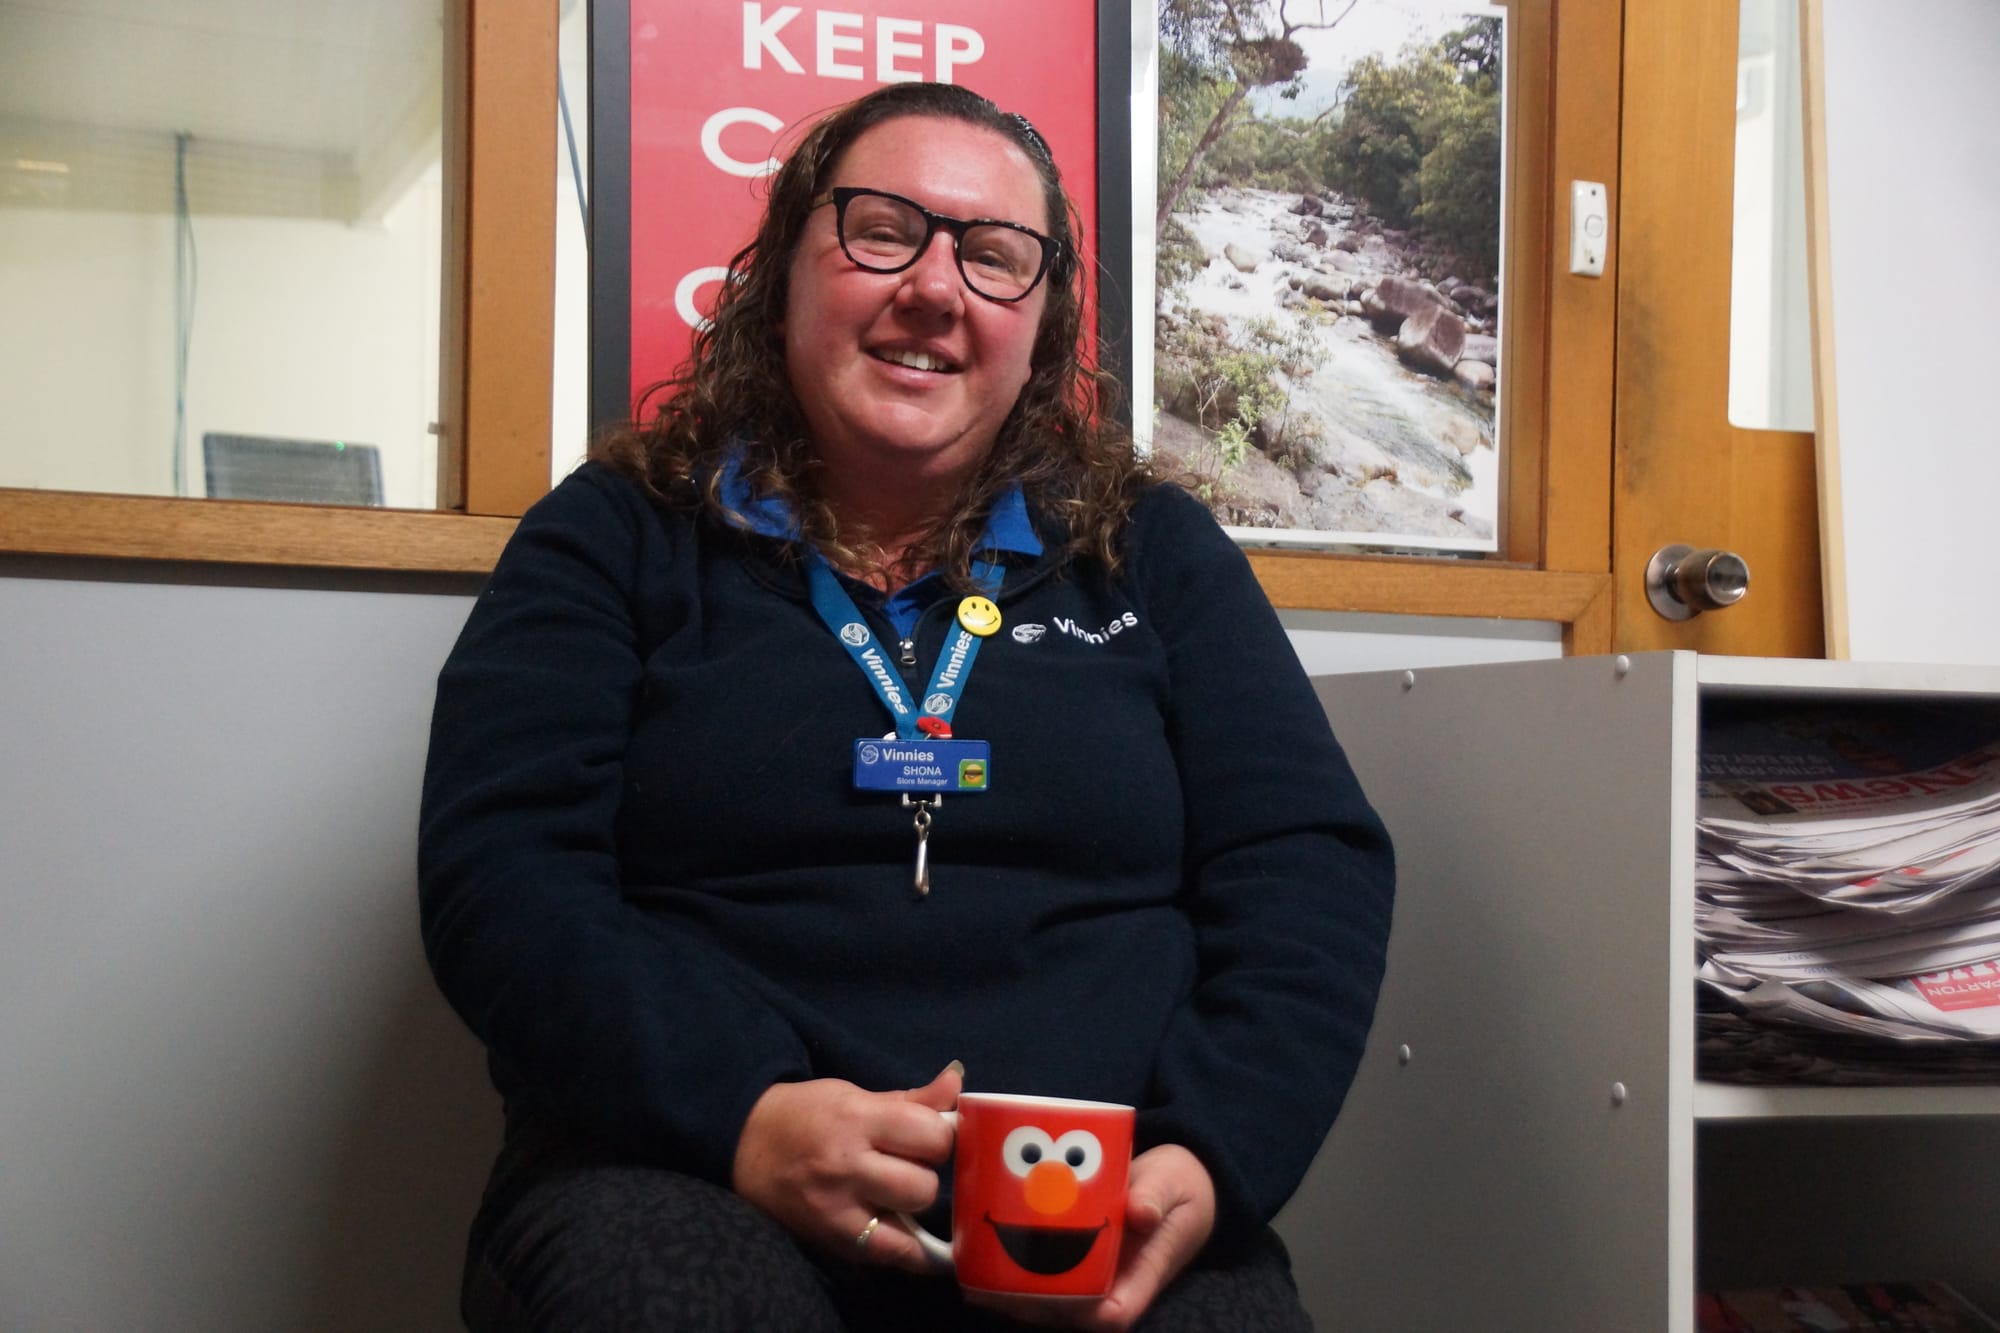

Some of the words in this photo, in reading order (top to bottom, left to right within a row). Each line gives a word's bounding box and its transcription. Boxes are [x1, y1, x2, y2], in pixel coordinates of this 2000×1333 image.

[741, 1, 985, 85] KEEP
[1053, 611, 1138, 644] Vinnies
[936, 630, 974, 689] Vinnies
[861, 647, 909, 714] Vinnies
[882, 748, 935, 761] Vinnies
[903, 766, 942, 775] SHONA
[917, 778, 948, 787] Manager
